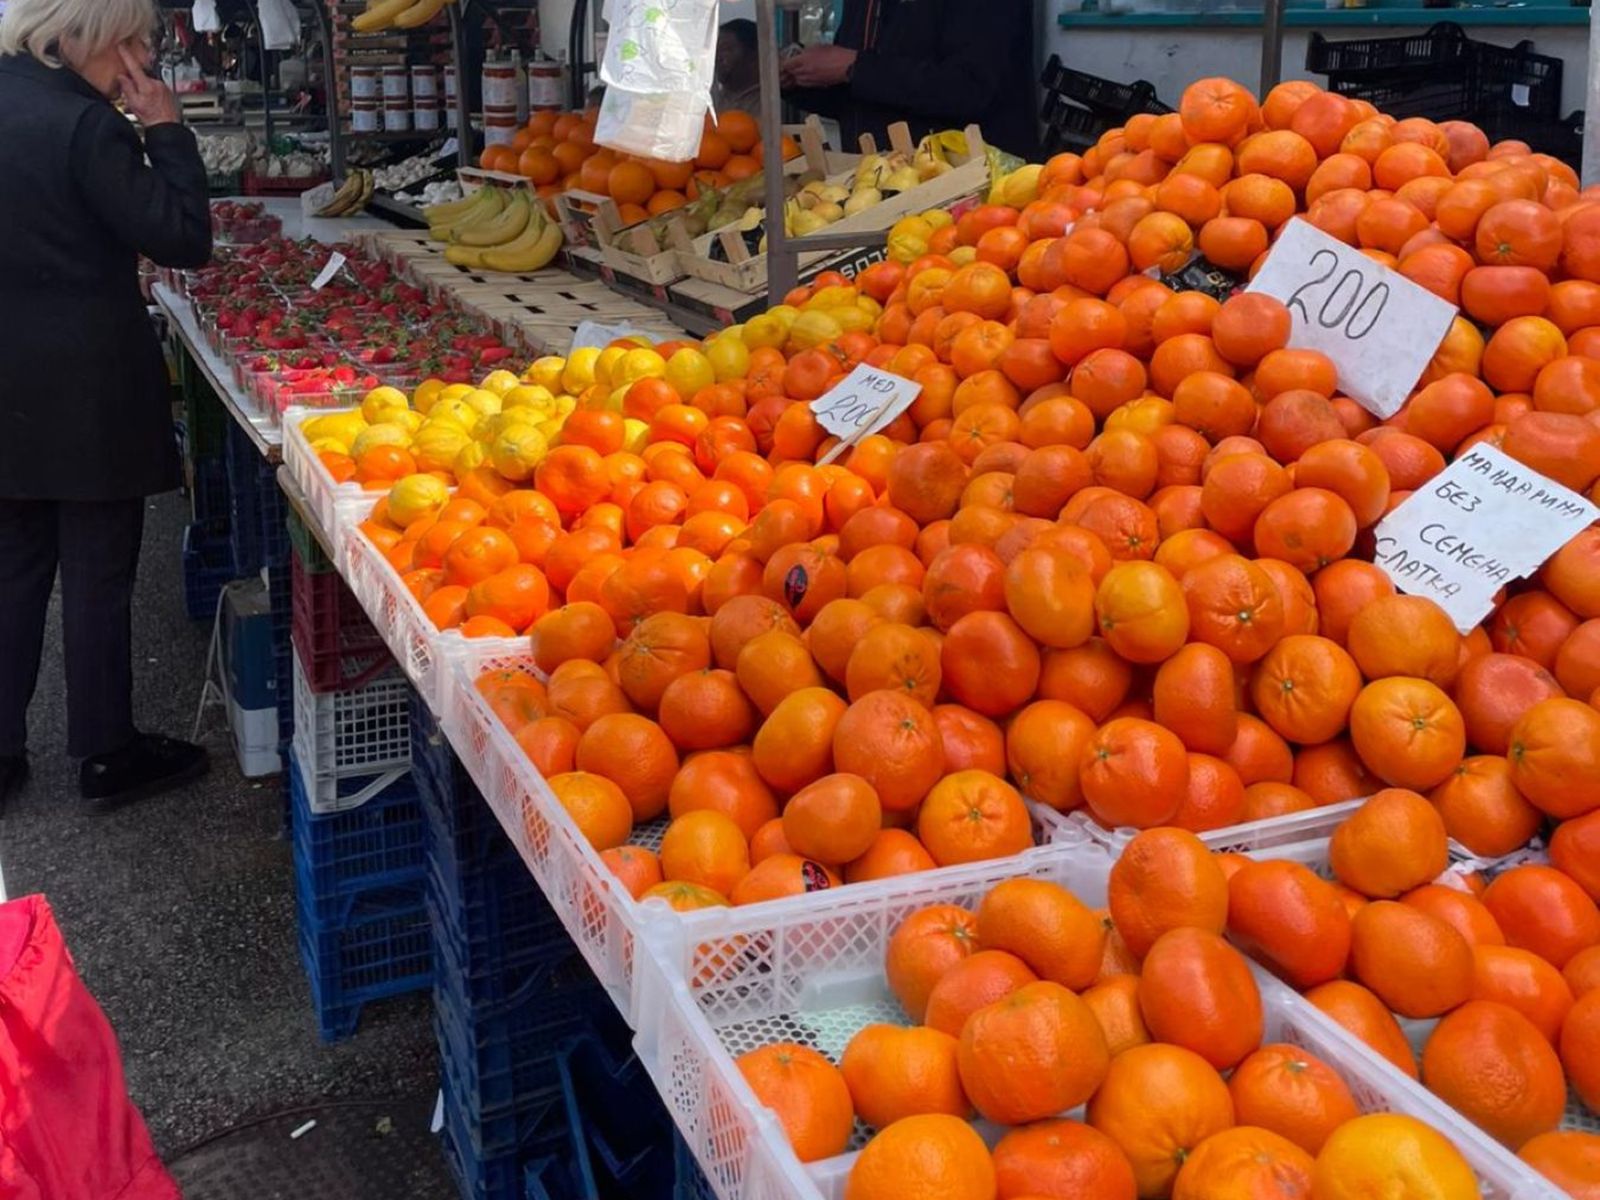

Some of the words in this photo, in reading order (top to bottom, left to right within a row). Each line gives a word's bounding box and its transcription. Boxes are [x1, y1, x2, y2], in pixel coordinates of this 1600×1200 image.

[1286, 249, 1389, 340] 200
[860, 374, 896, 393] MED
[1435, 480, 1482, 512] БЕЗ
[1375, 537, 1462, 599] СЛАТКА
[1419, 523, 1510, 584] СЕМЕНА
